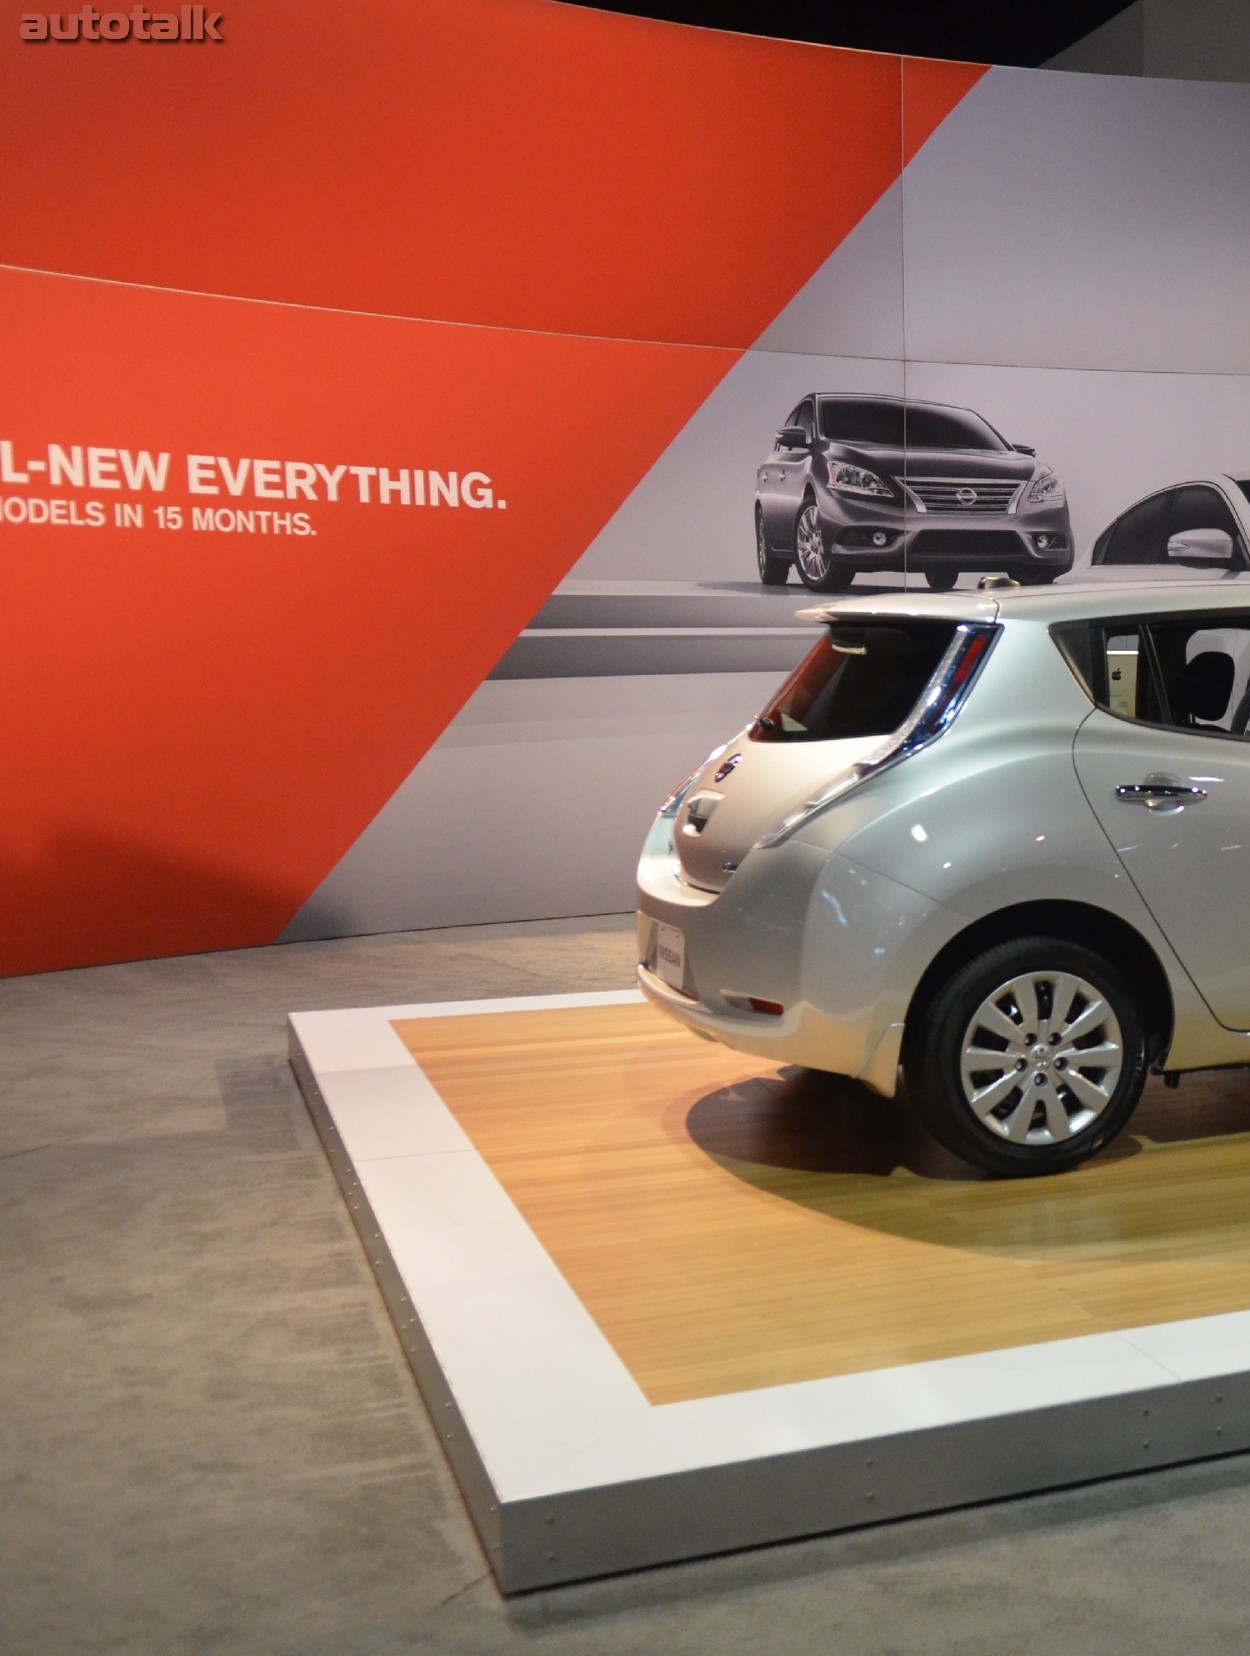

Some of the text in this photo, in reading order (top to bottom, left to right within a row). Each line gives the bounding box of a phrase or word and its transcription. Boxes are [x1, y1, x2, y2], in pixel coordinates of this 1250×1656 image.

[0, 440, 508, 510] L-NEW EVERYTHING.
[0, 496, 317, 536] ODELS IN 15 MONTHS.
